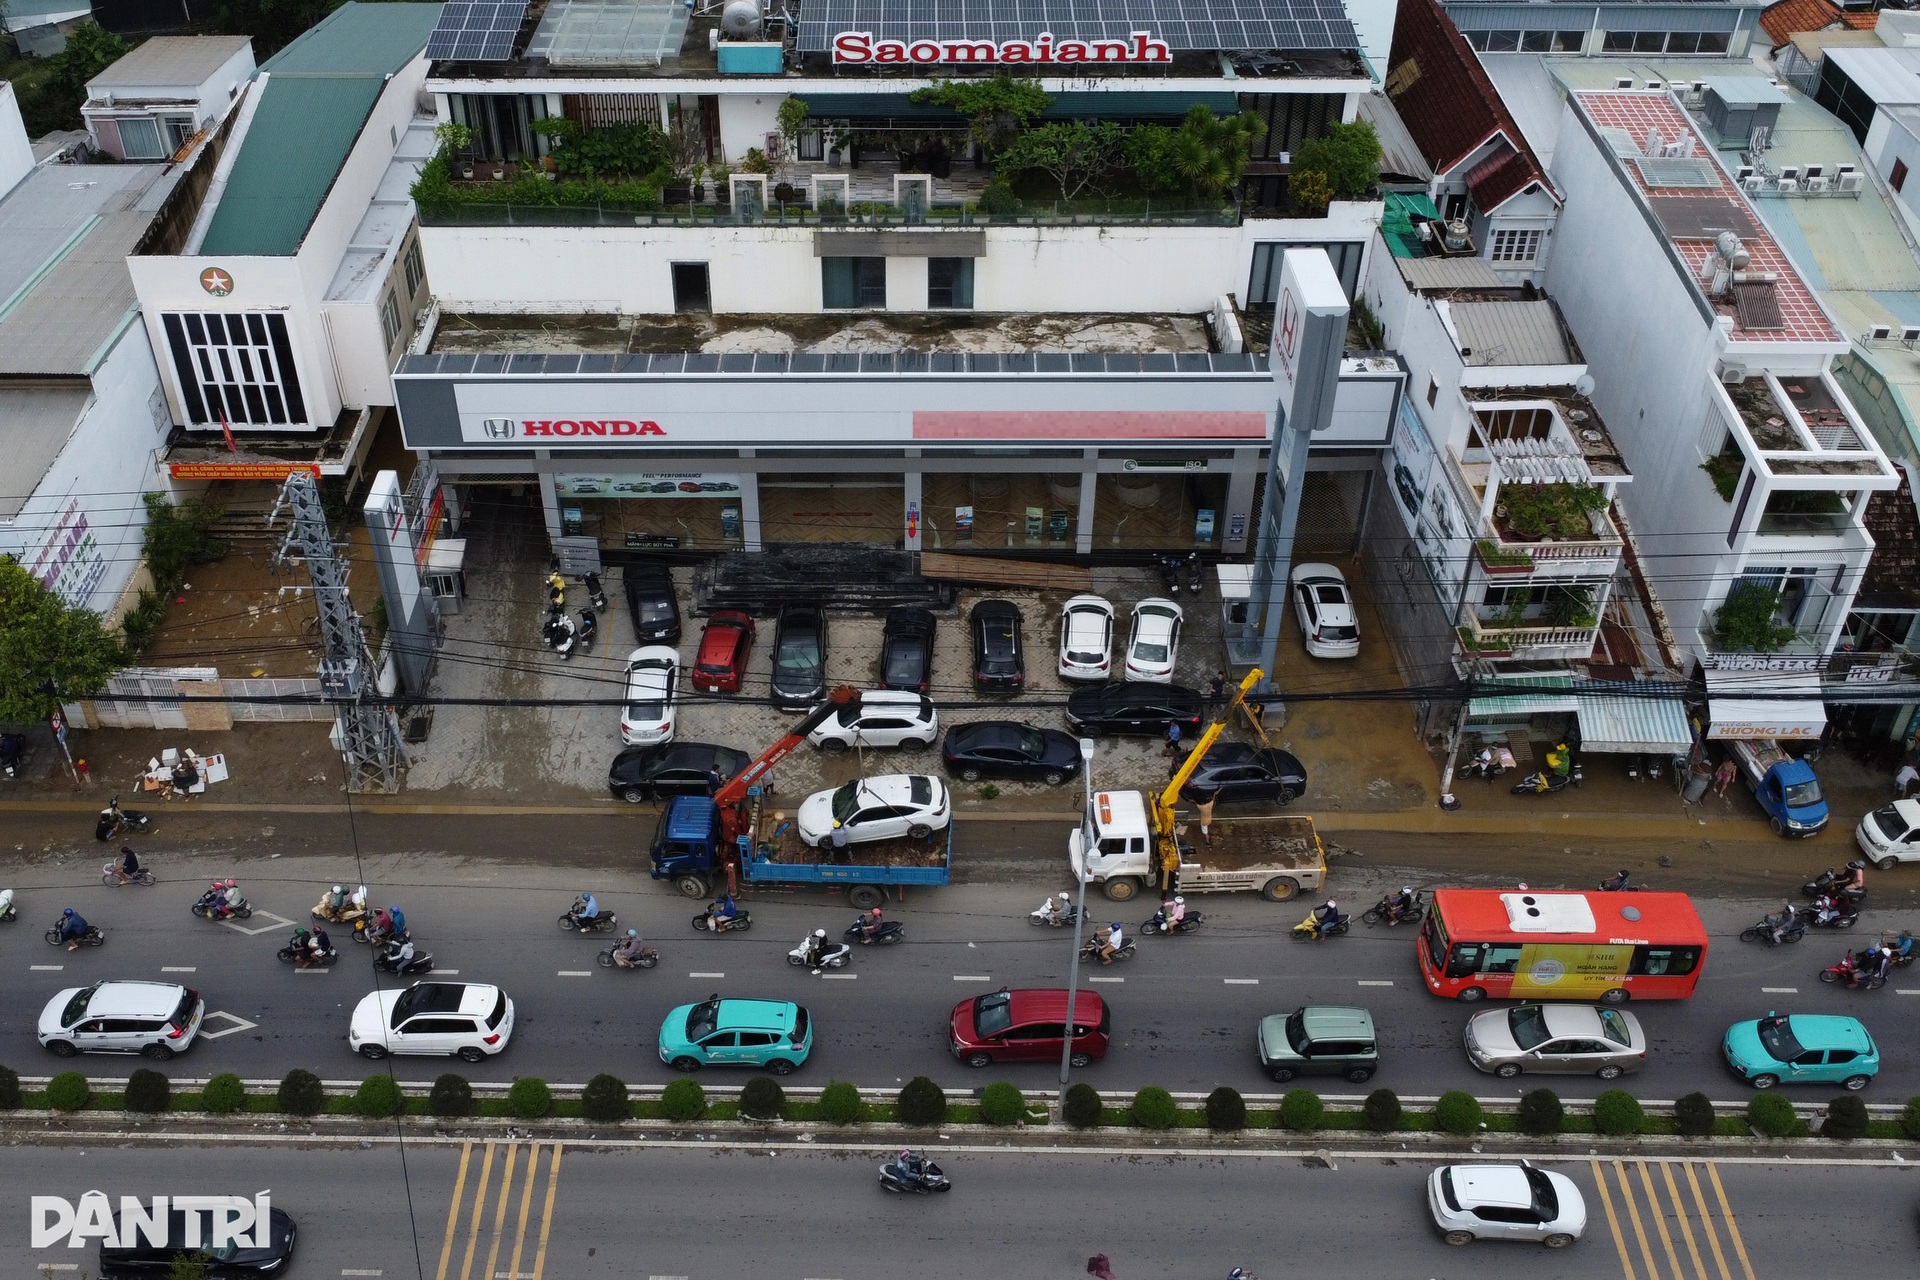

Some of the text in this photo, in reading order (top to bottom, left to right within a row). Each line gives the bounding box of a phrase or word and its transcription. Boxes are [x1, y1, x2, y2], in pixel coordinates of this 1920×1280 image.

[834, 33, 1171, 62] Saomaianh
[522, 420, 667, 436] HONDA
[1720, 727, 1777, 735] HƯƠNG
